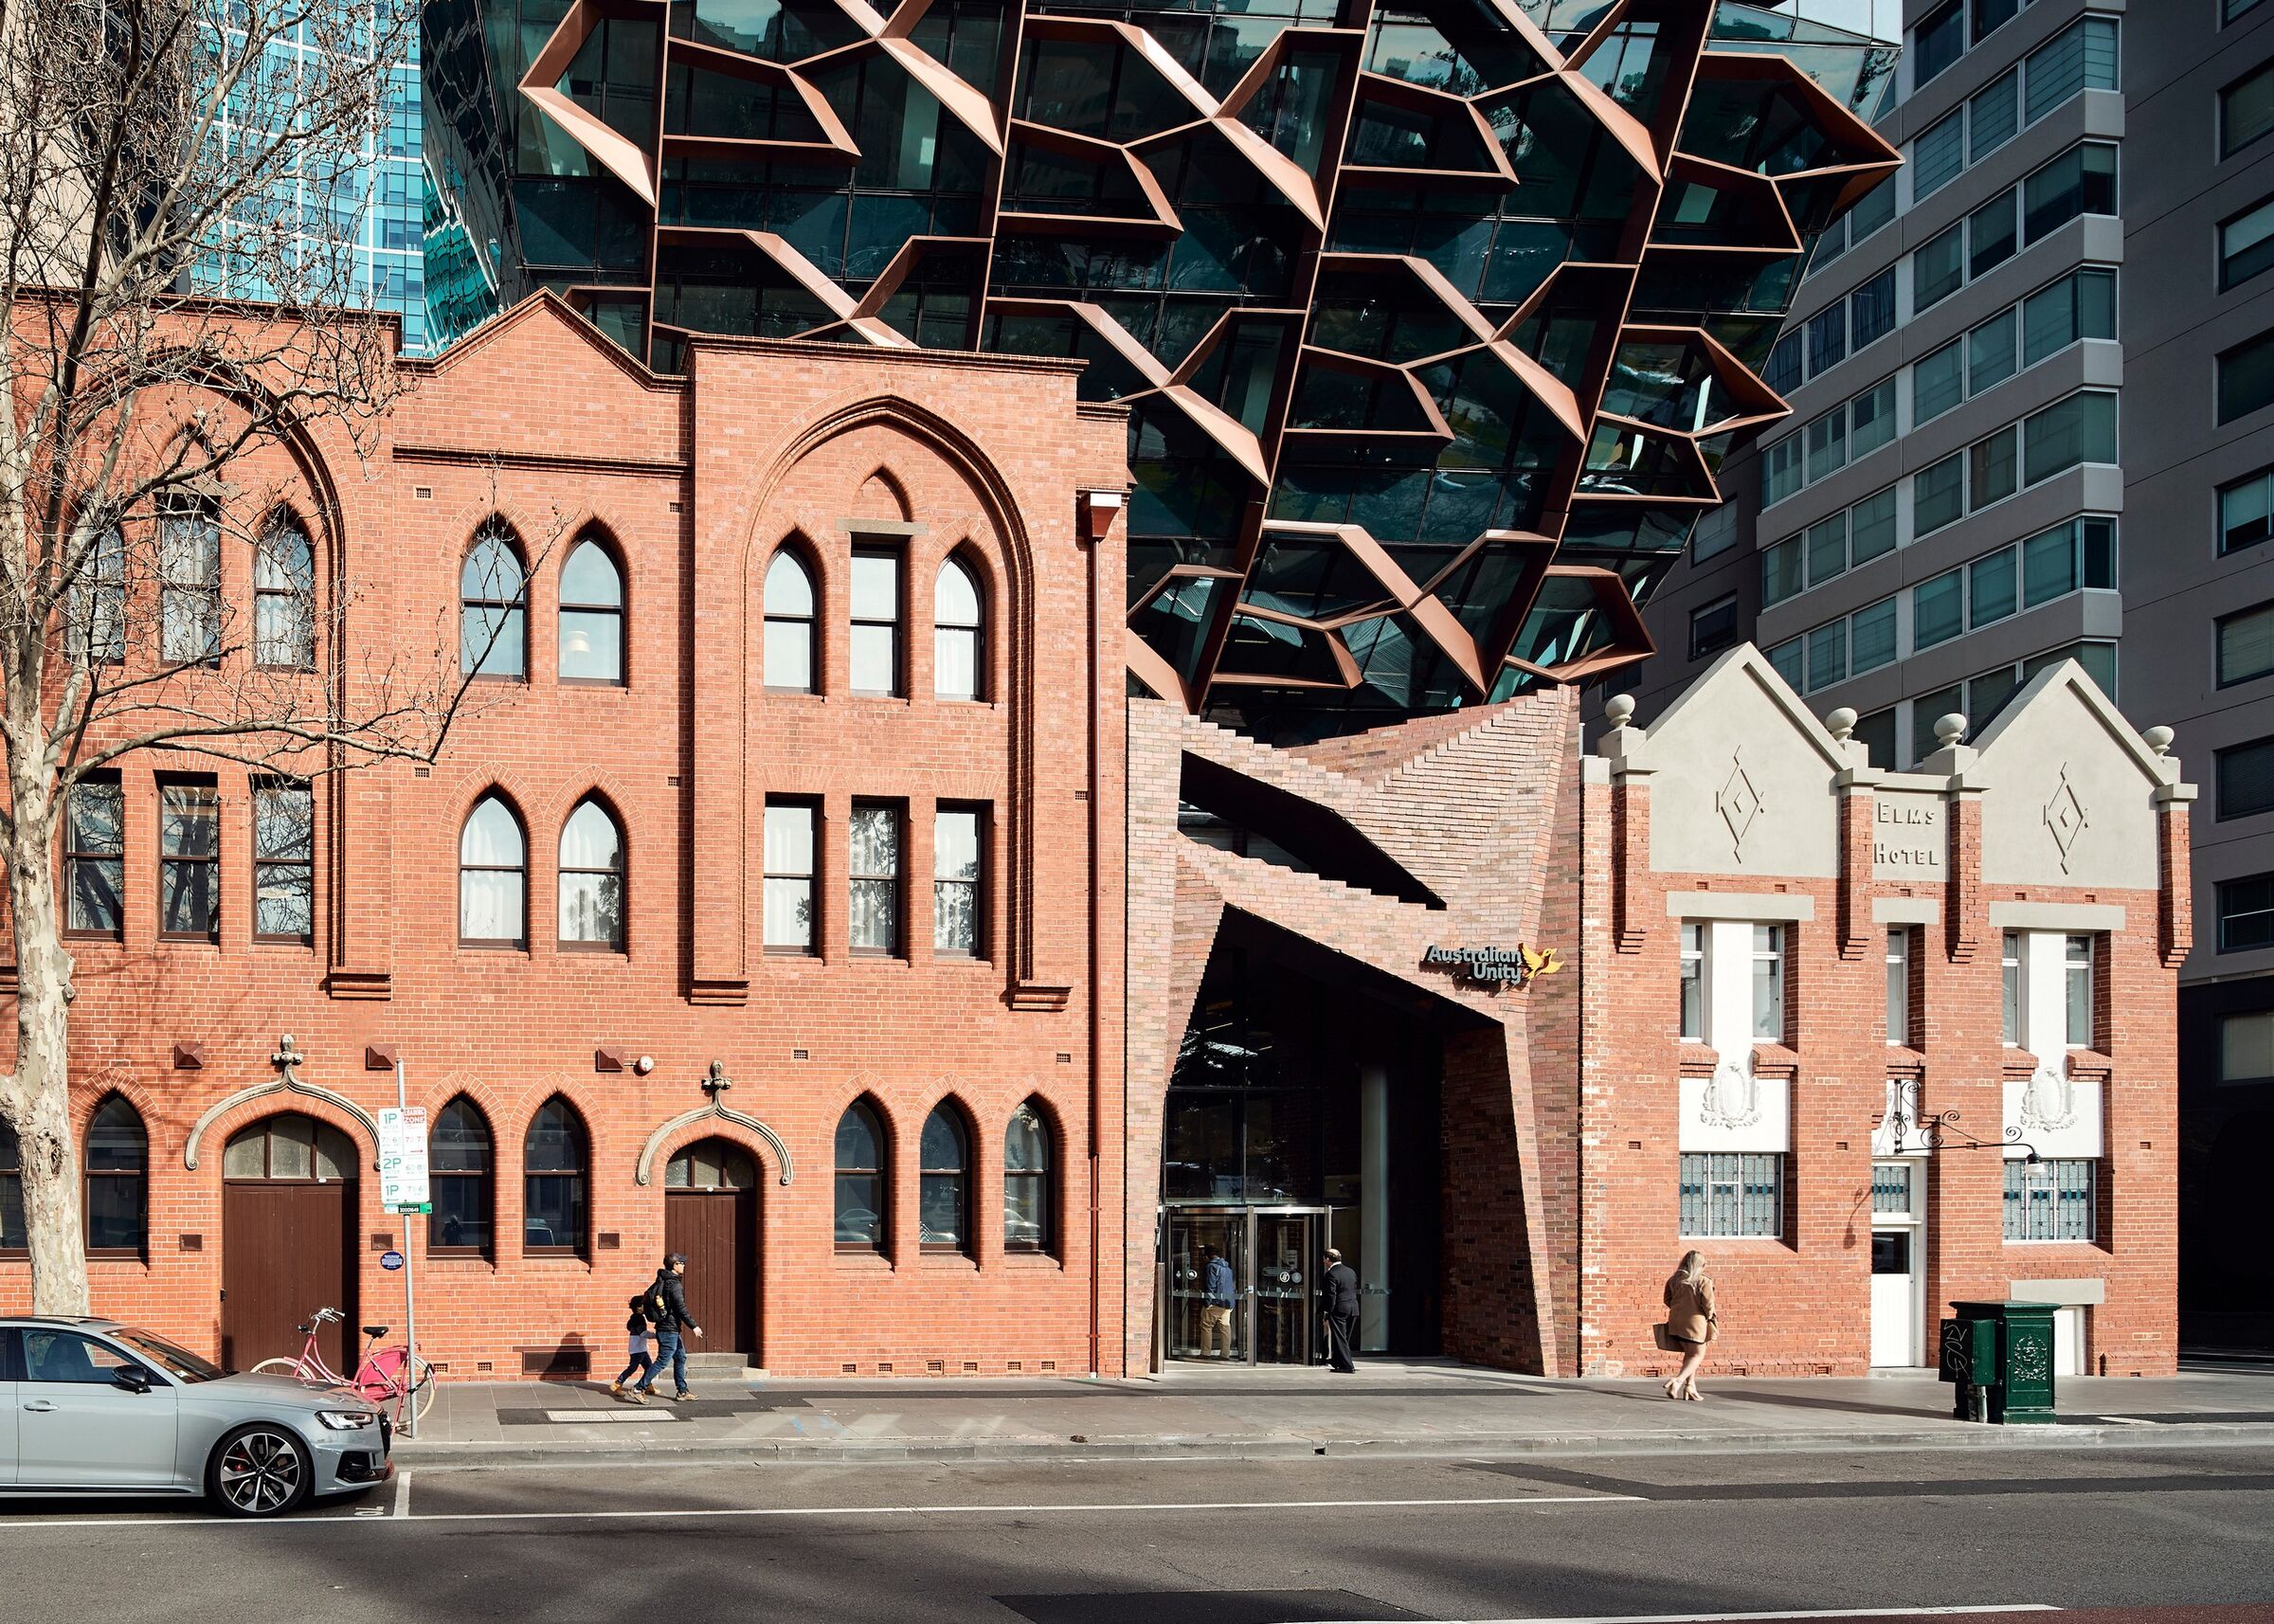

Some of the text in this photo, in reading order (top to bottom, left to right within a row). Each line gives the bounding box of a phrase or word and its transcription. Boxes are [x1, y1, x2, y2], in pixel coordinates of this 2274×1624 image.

[1877, 802, 1935, 824] ELMS
[1873, 843, 1940, 865] HOTEL
[1427, 945, 1522, 963] Australian
[1473, 963, 1522, 983] Unity
[384, 1113, 397, 1125] 1P
[383, 1158, 402, 1169] 2P
[386, 1185, 399, 1196] 1P
